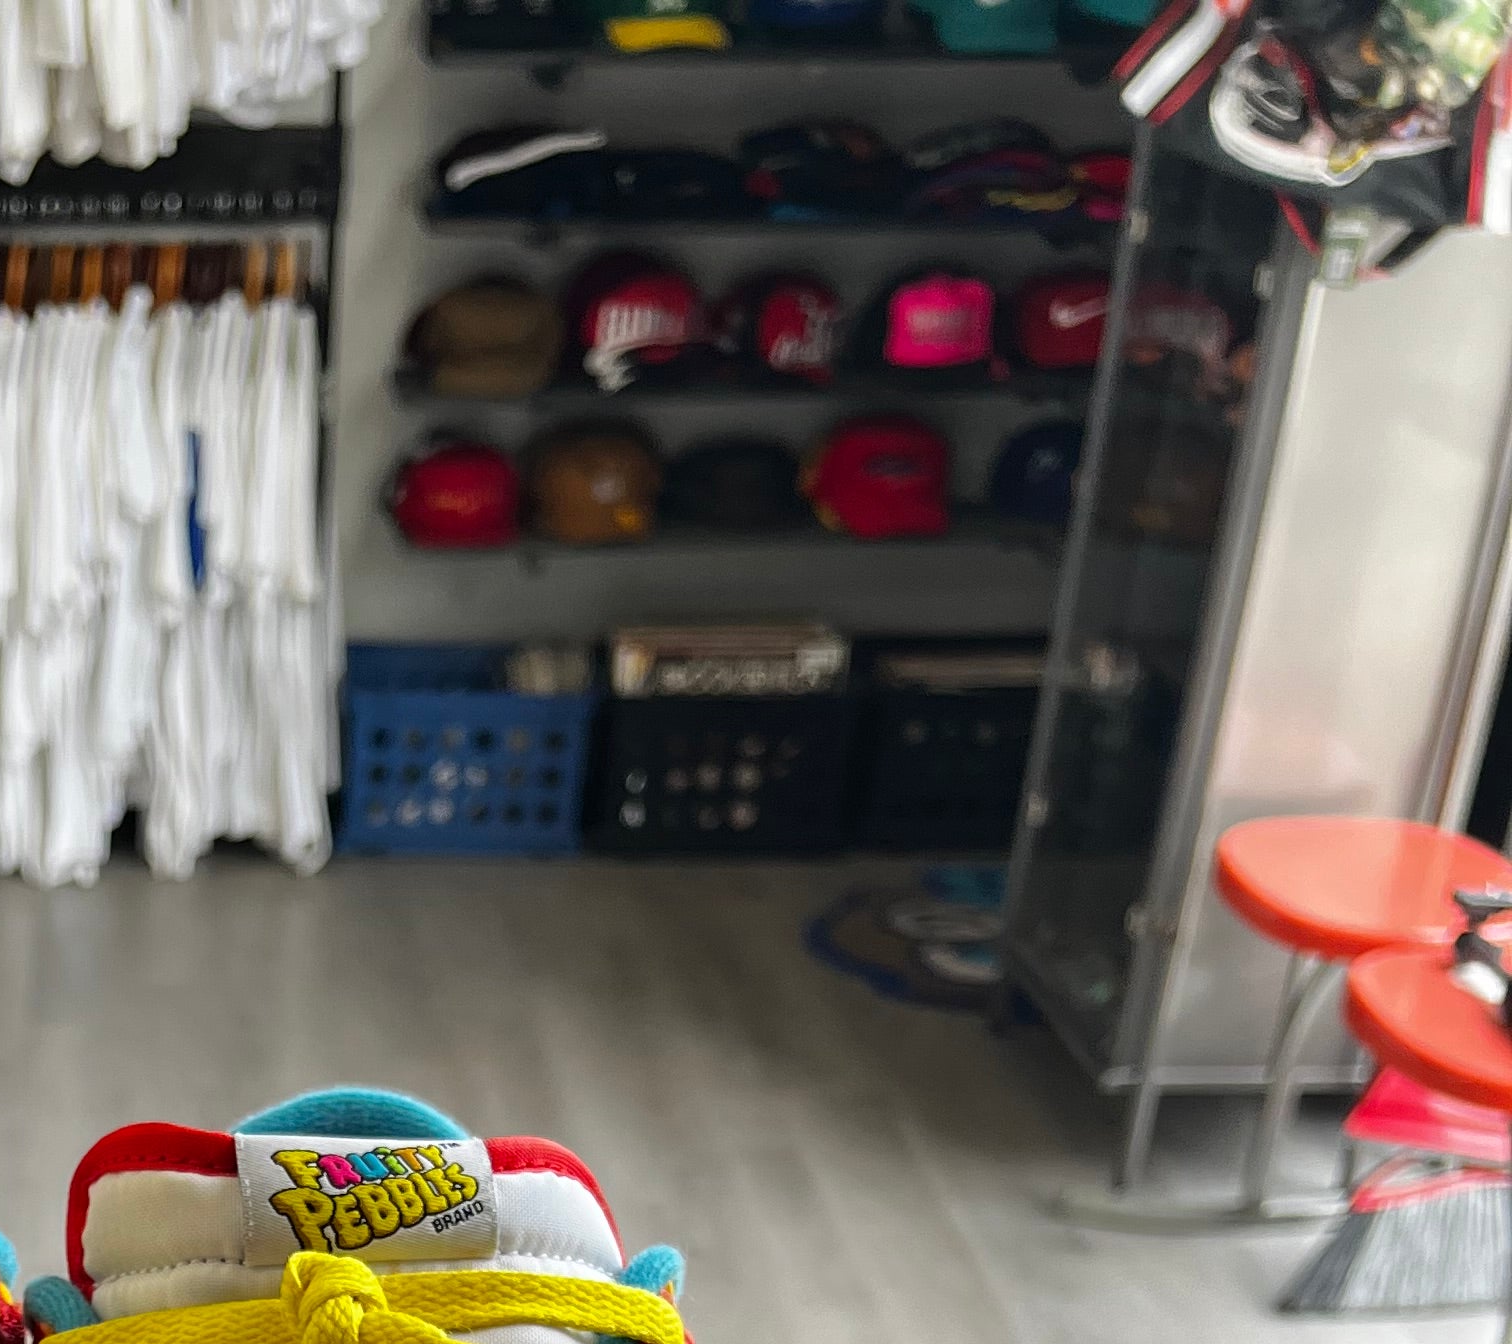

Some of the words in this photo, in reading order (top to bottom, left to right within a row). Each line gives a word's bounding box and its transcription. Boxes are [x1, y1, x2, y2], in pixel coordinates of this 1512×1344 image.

[270, 1145, 447, 1190] FRUITY
[268, 1162, 479, 1252] PEBBLES
[430, 1200, 485, 1234] BRAND
